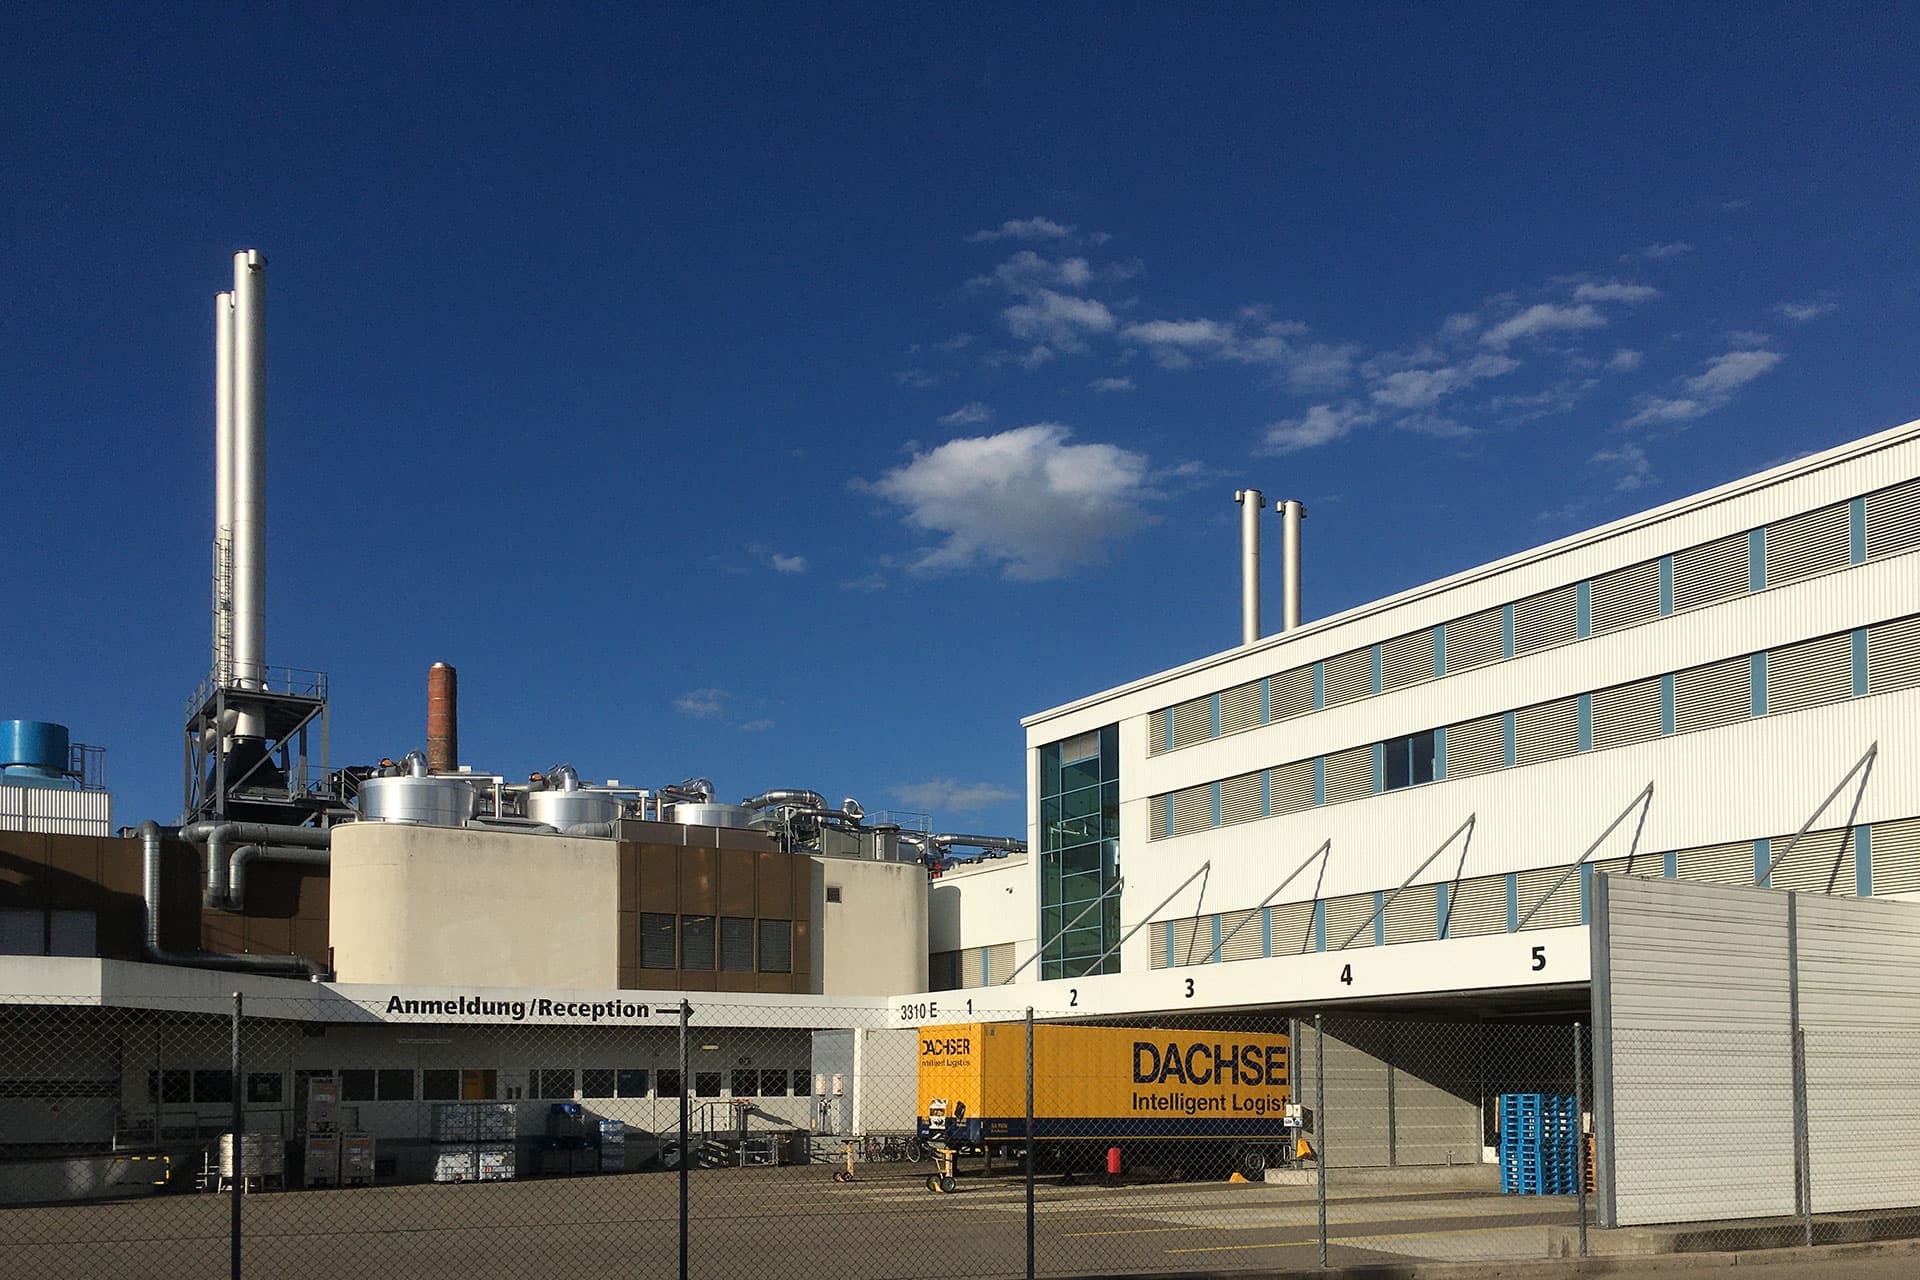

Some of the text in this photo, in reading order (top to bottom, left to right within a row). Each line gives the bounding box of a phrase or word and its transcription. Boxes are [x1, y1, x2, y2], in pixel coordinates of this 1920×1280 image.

[1531, 946, 1546, 972] 5
[1340, 964, 1353, 986] 4
[1069, 988, 1078, 1007] 2
[1184, 978, 1195, 998] 3
[386, 995, 650, 1021] Anmeldung/Reception
[901, 1002, 937, 1020] 3310 E
[966, 999, 973, 1015] 1
[922, 1038, 970, 1055] DACHSER
[1133, 1042, 1291, 1086] DACHSE
[1133, 1092, 1226, 1115] Intelligent
